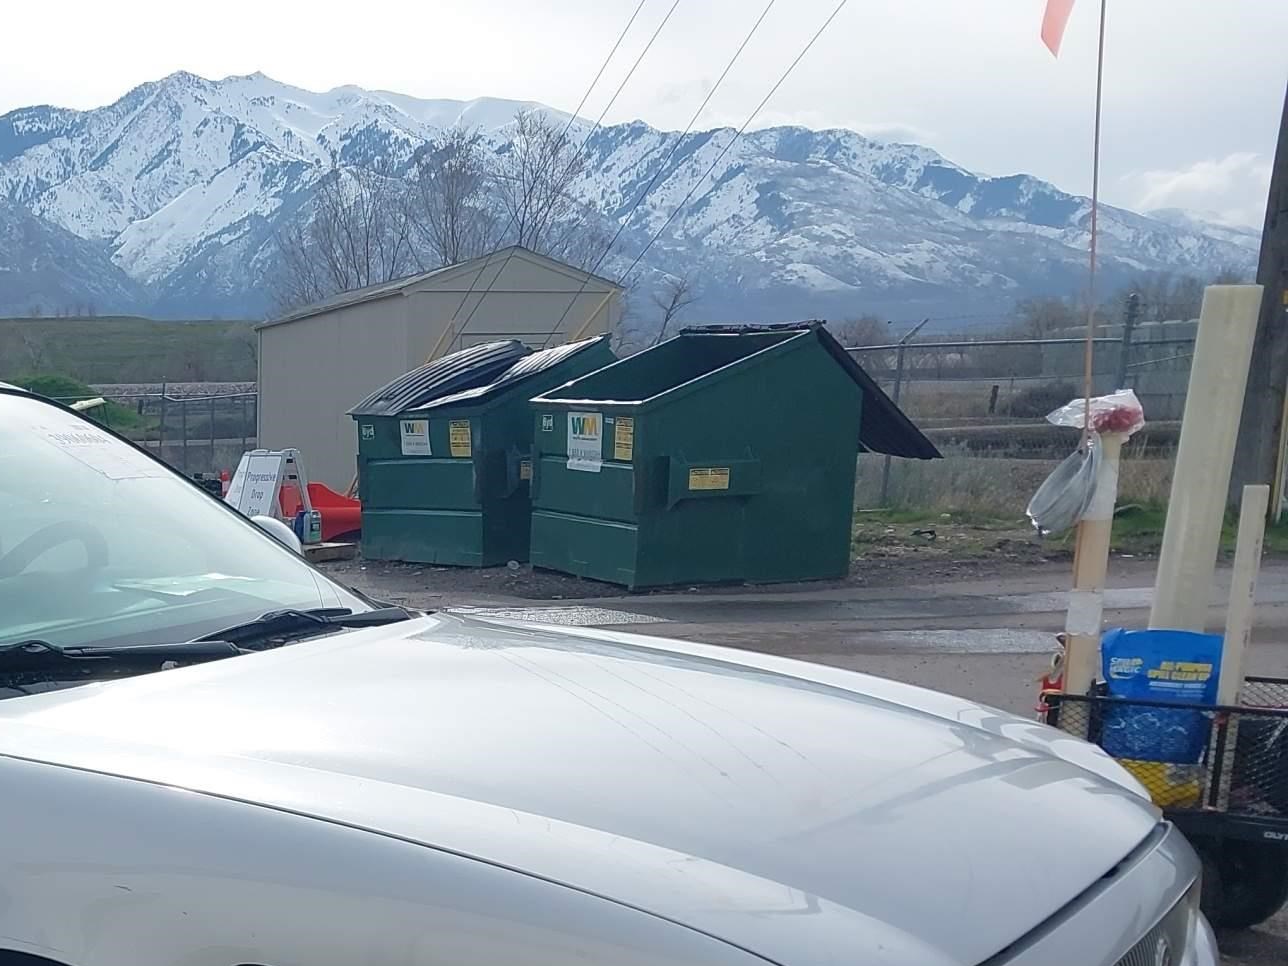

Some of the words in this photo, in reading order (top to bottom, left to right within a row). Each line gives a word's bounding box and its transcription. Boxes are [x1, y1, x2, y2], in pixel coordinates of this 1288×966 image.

[571, 416, 598, 436] WM
[247, 471, 279, 484] Progressive
[250, 489, 264, 501] Drop
